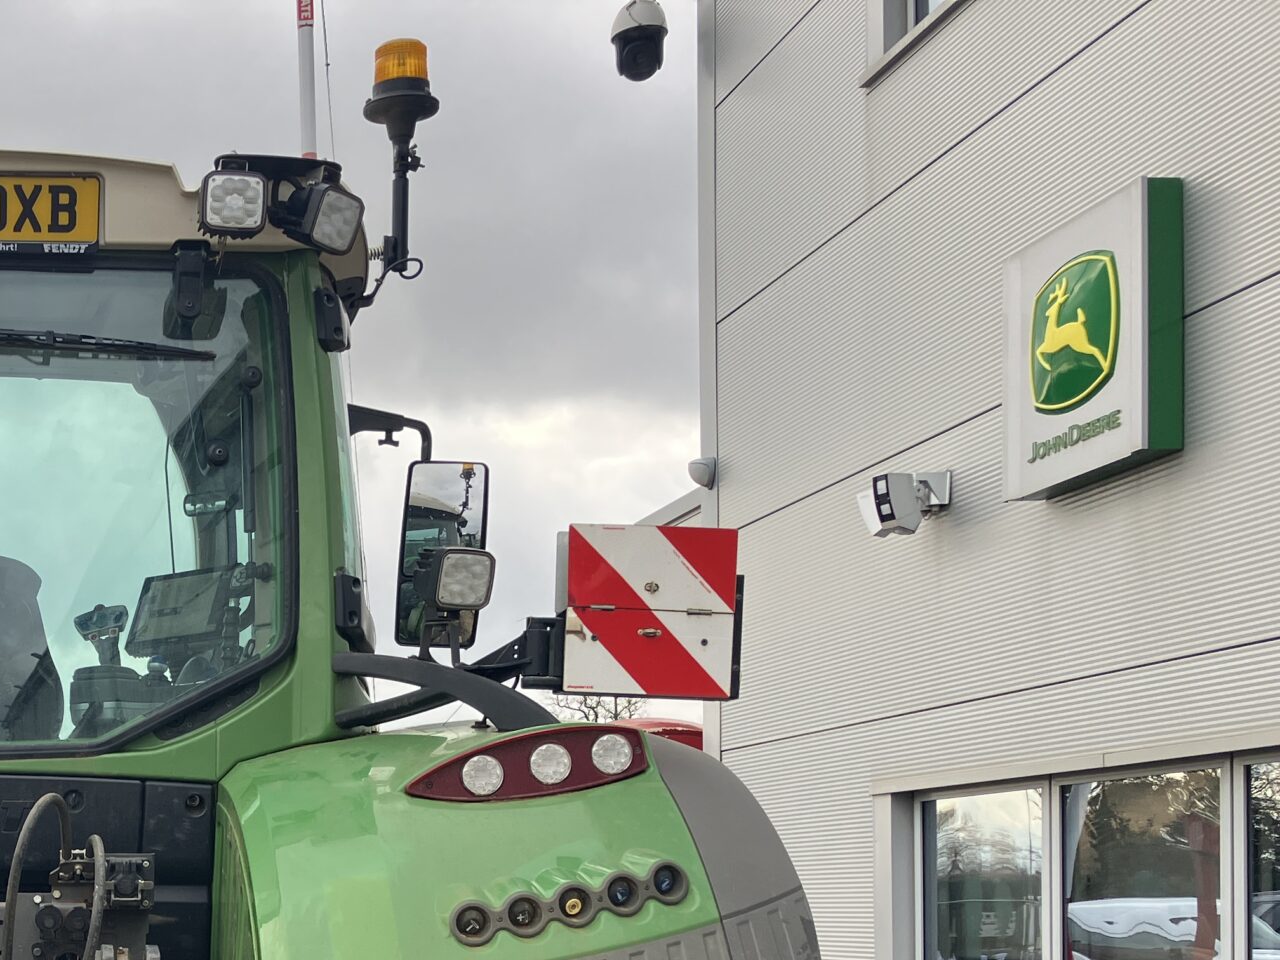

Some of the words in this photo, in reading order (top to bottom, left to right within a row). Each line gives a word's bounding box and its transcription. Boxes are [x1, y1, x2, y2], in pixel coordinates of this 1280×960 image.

[43, 243, 89, 254] FENDT
[1027, 431, 1068, 464] JOHN
[1068, 409, 1122, 447] DEERE
